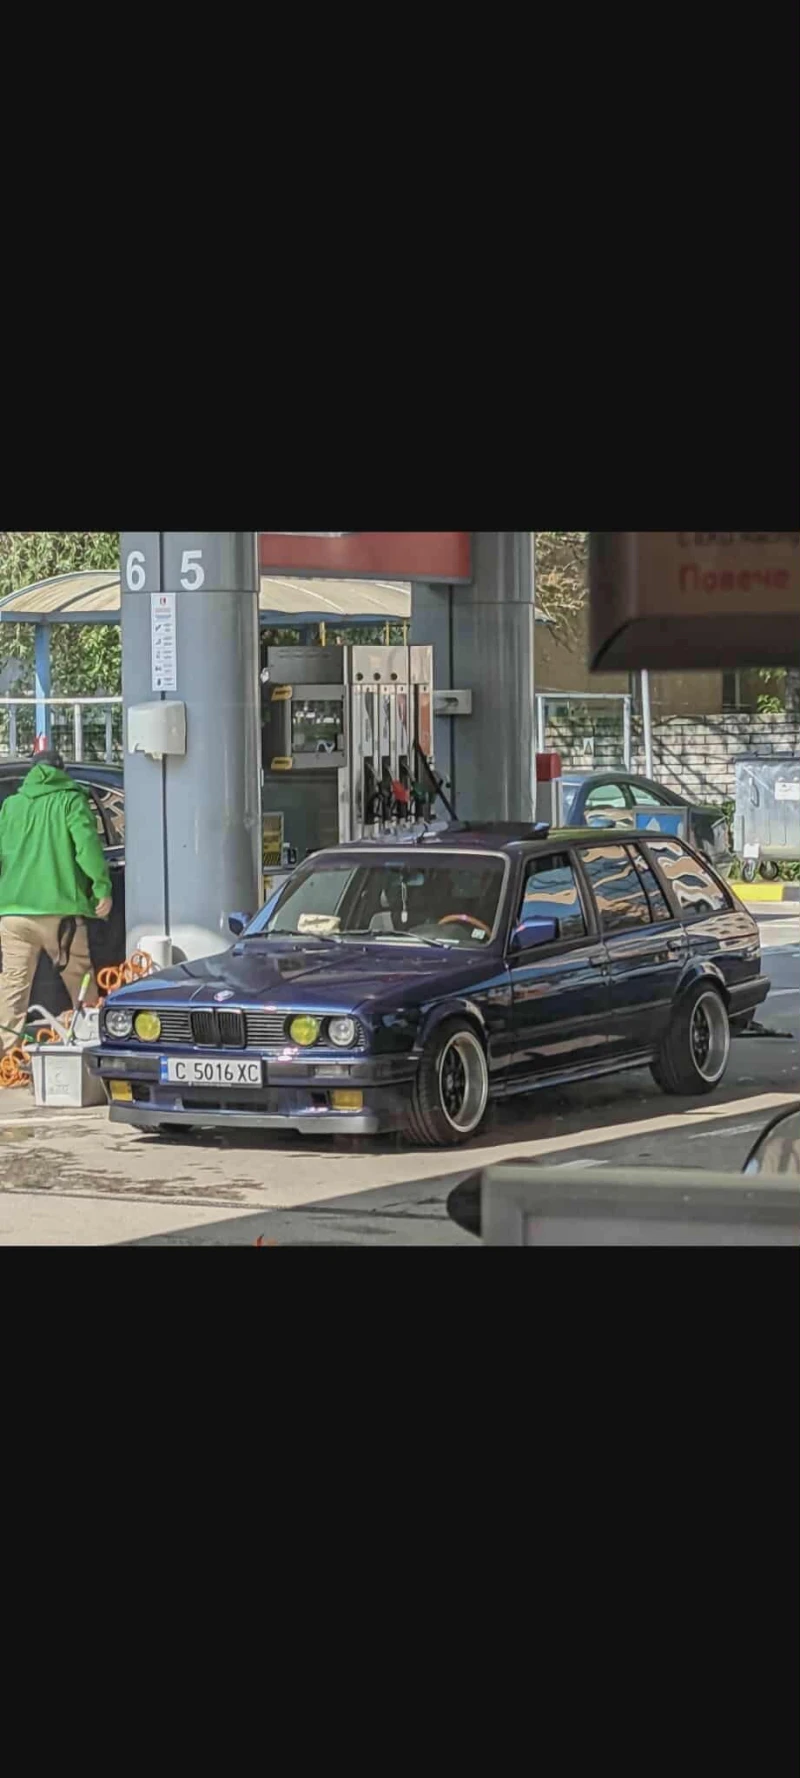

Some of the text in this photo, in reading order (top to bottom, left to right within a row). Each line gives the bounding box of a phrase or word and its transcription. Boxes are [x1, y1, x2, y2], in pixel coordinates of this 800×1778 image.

[126, 550, 205, 591] 6 5
[194, 1062, 234, 1081] 5016
